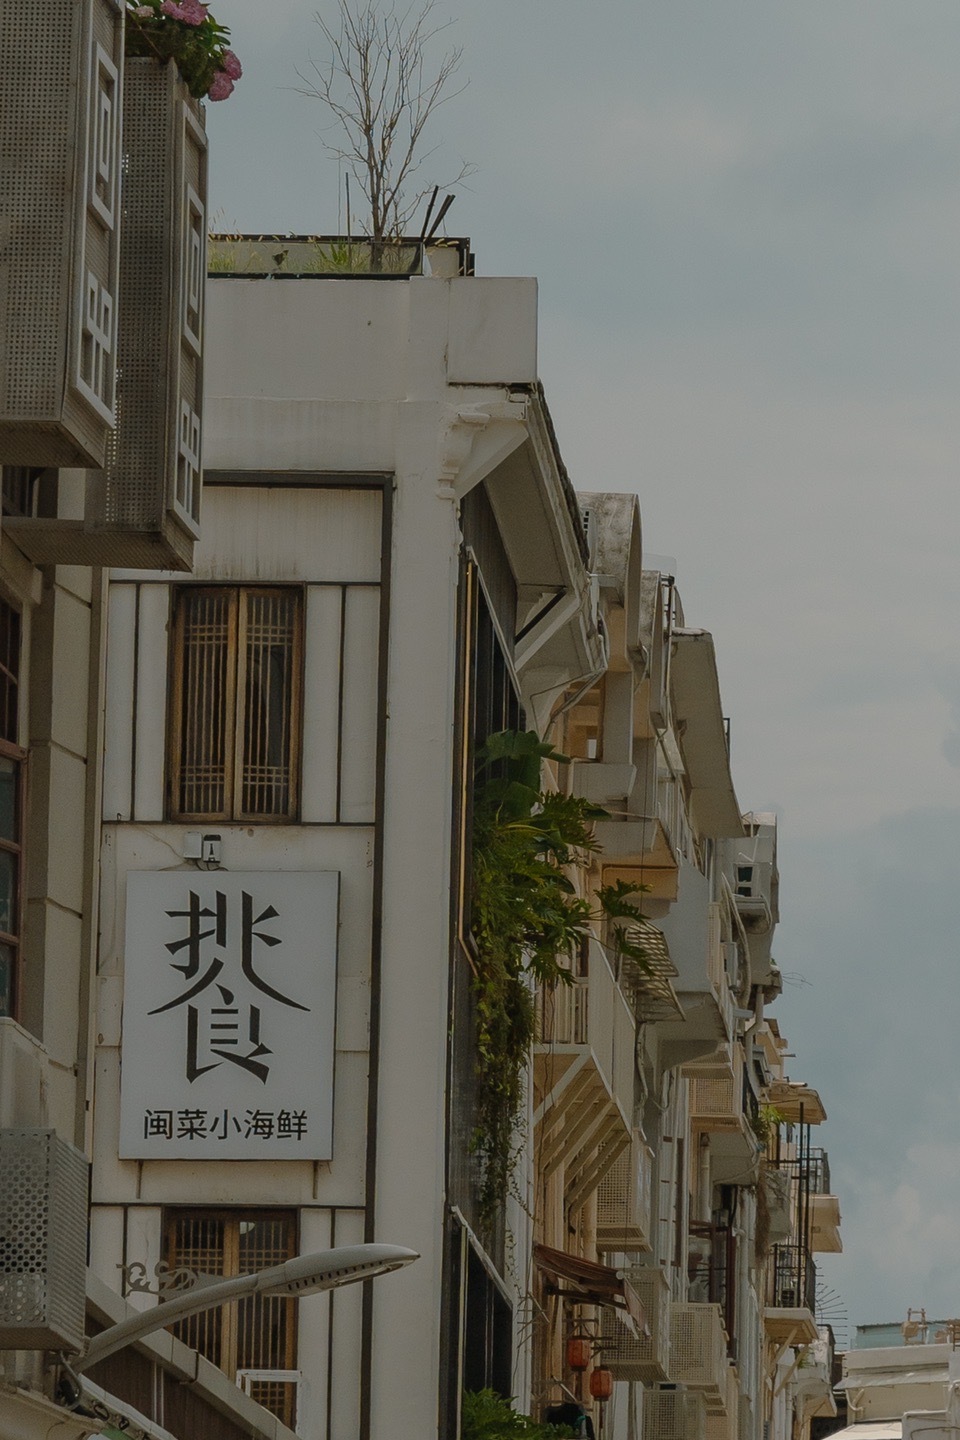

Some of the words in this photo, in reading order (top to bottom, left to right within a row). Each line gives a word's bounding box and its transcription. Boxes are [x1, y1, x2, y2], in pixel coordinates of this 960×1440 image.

[143, 1109, 308, 1141] 闽菜小海鲜
